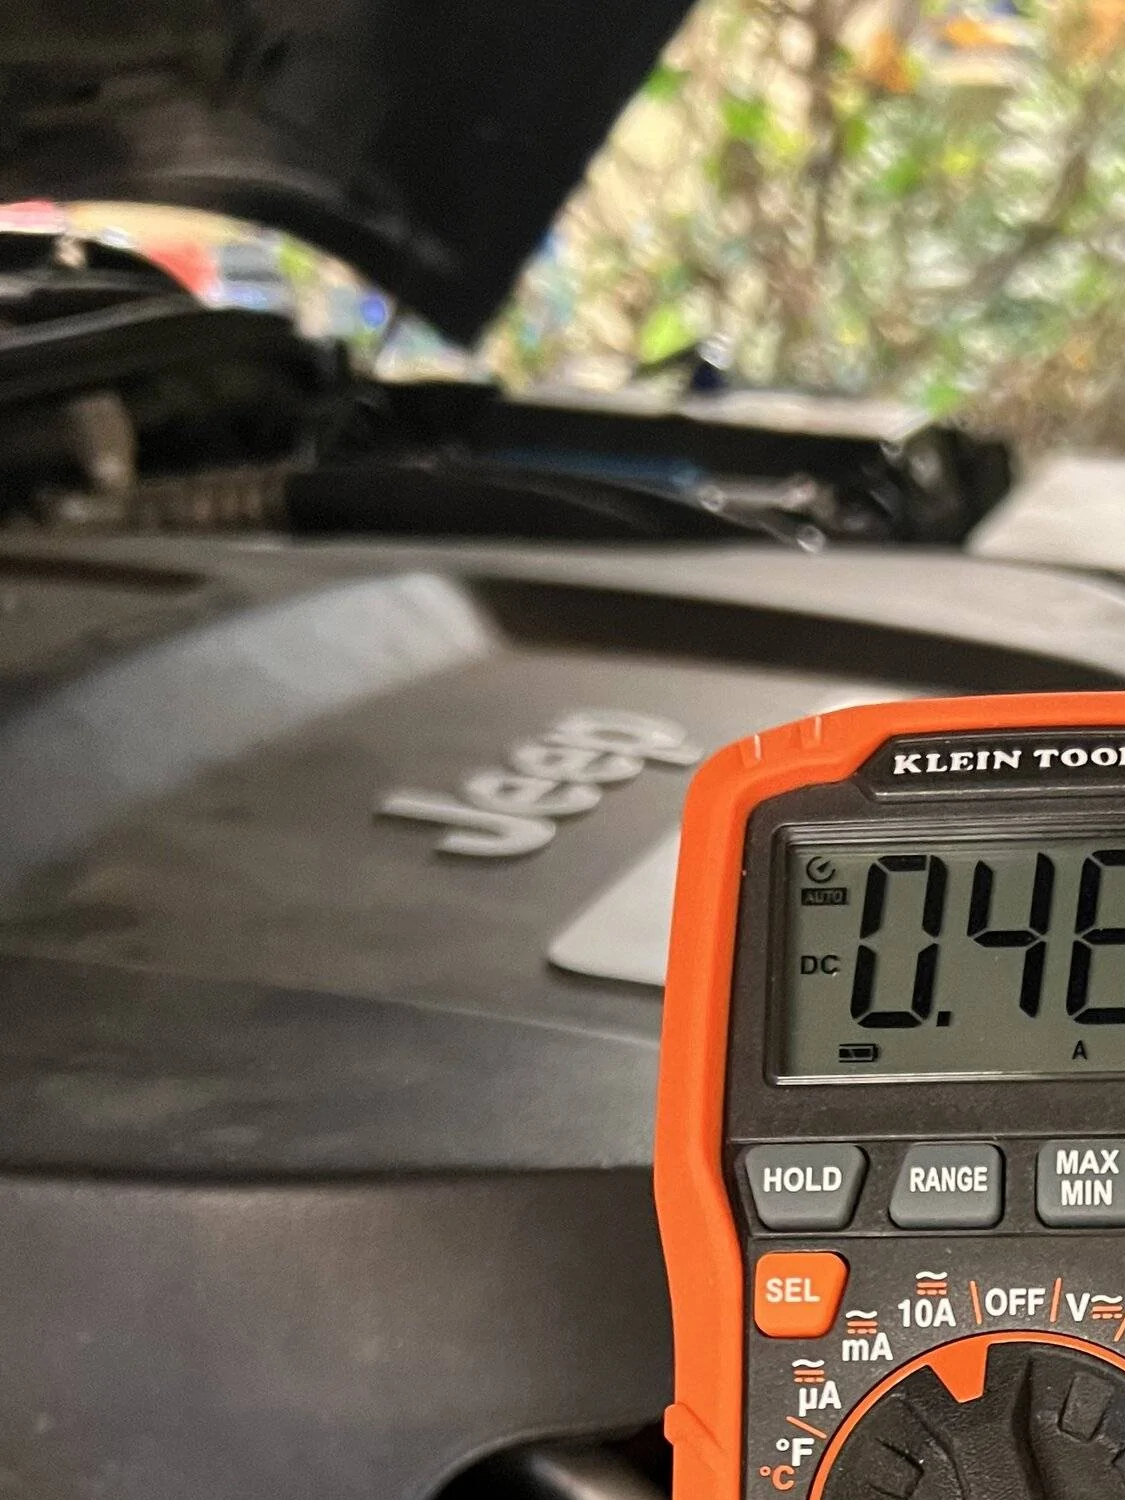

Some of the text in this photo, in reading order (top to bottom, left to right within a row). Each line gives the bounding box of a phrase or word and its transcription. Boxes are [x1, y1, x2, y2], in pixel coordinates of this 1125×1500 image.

[893, 749, 1022, 775] KLEIN
[376, 708, 704, 857] Jeep
[801, 888, 847, 905] AUTO
[800, 954, 840, 975] DC
[1072, 1040, 1088, 1061] A
[1056, 1150, 1119, 1174] MAX
[763, 1167, 842, 1193] HOLD
[909, 1166, 988, 1193] RANGE
[1061, 1179, 1112, 1206] MIN
[766, 1278, 820, 1302] SEL
[985, 1288, 1045, 1316] OFF
[898, 1298, 956, 1328] 10A
[1066, 1293, 1091, 1322] V
[842, 1332, 893, 1361] mA
